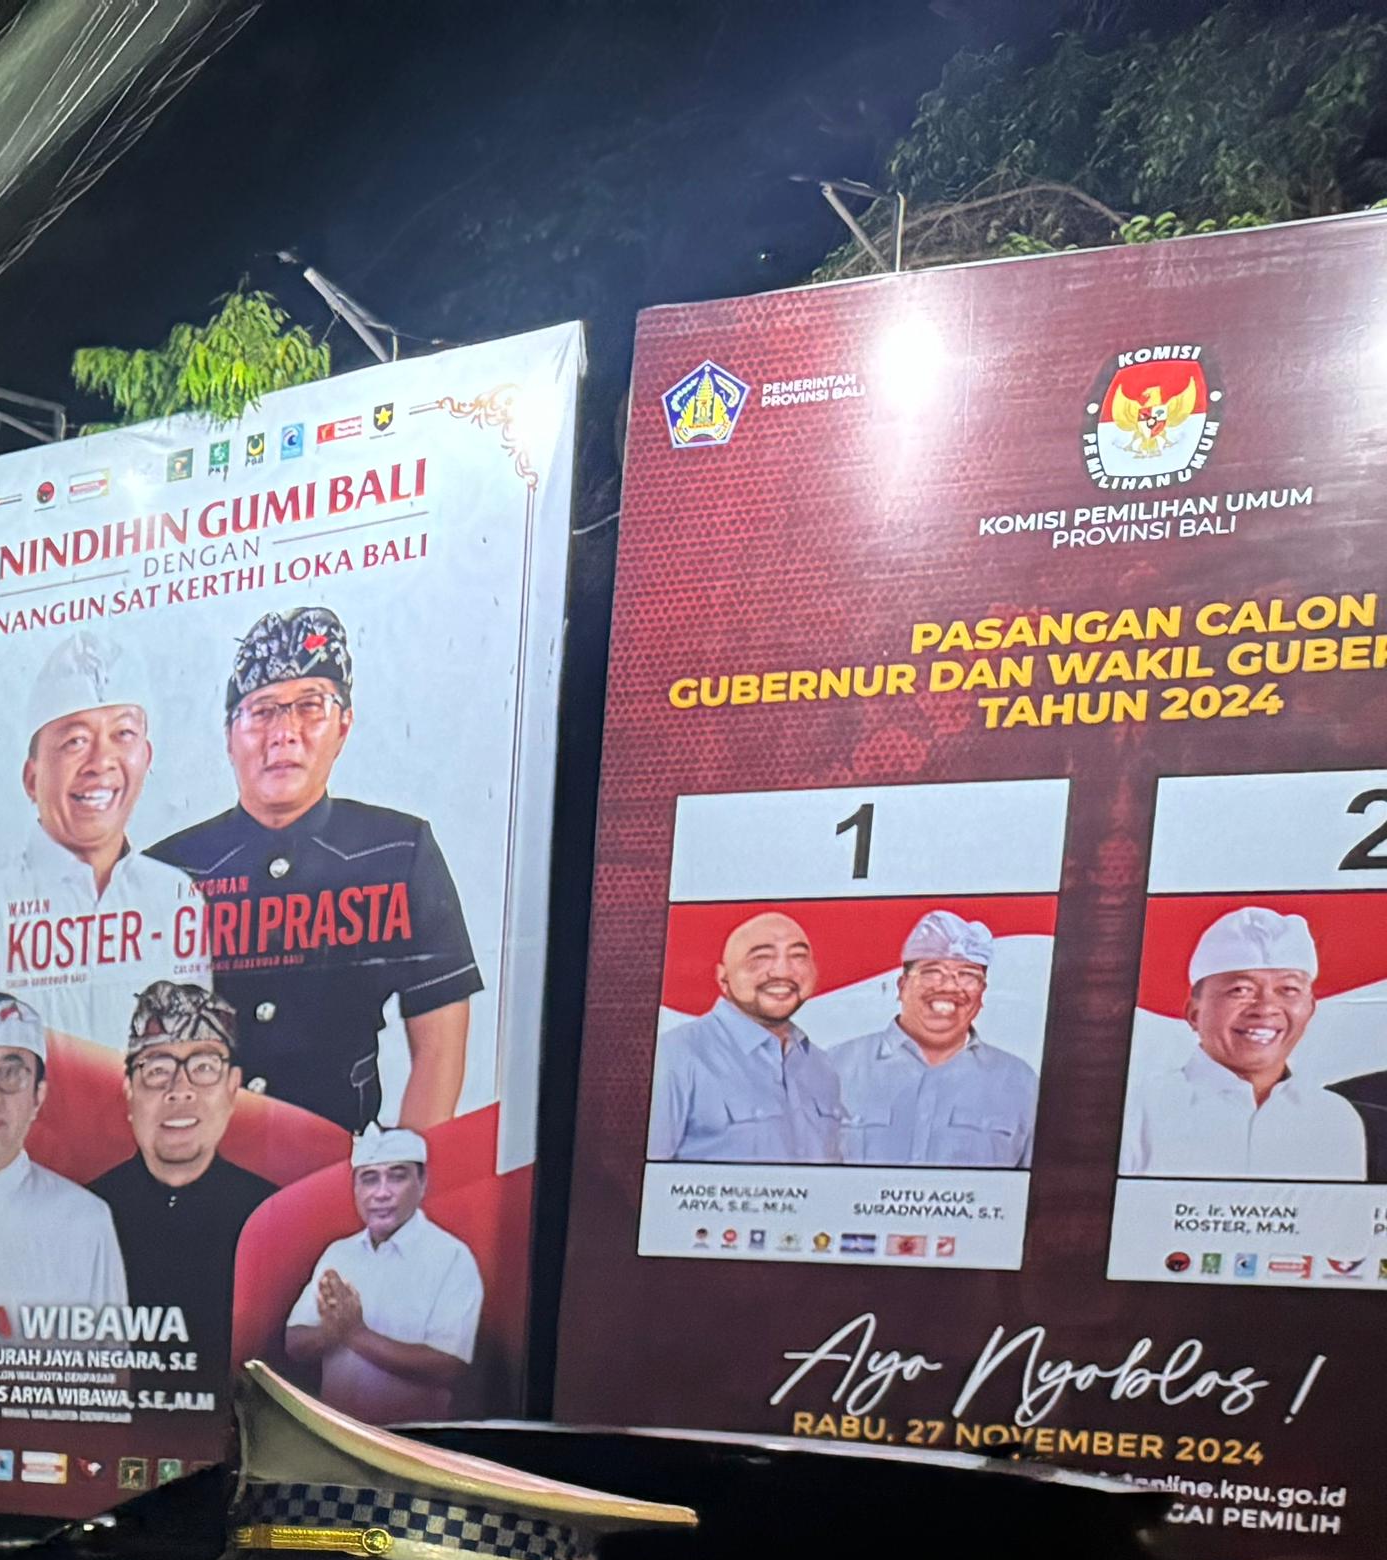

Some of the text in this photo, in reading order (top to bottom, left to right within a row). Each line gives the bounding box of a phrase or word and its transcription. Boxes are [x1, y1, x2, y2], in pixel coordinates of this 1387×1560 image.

[1117, 345, 1201, 368] KOMISI
[761, 384, 867, 408] PROVINSI BALI
[762, 373, 857, 395] PEMERINTAH
[1082, 420, 1220, 490] PEMILIHAN UMUM
[198, 481, 317, 539] GUMI
[327, 457, 428, 514] BALI
[978, 486, 1313, 536] KOMISI PEMILIHAN UMUM
[1051, 514, 1236, 549] PROVINSI BALI
[109, 584, 162, 615] SAT
[166, 564, 266, 605] KERTHI
[273, 548, 354, 585] LOKA
[363, 533, 428, 570] BALI
[144, 536, 262, 578] DENGAN
[910, 593, 1378, 656] PASANGAN CALON
[668, 662, 915, 711] GUBERNUR
[929, 653, 1035, 696] DAN
[1046, 643, 1214, 686] WAKIL
[977, 682, 1285, 730] TAHUN 2024
[834, 802, 875, 880] 1
[1337, 788, 1387, 872] 2
[188, 875, 250, 897] NYOMAN
[8, 898, 51, 917] WAYAN
[7, 910, 143, 974] KOSTER
[670, 1184, 716, 1198] MADE
[880, 1189, 975, 1204] PUTU AGUS
[1173, 1219, 1300, 1235] KOSTER, M.M.
[1174, 1203, 1200, 1216] Dr.
[1229, 1204, 1298, 1219] WAYAN
[20, 1305, 190, 1343] WIBAWA
[43, 1349, 84, 1367] JAYA
[87, 1350, 166, 1372] NEGARA,
[770, 1312, 1327, 1427] Ayo Nyoblos !
[10, 1386, 56, 1405] ARYA
[57, 1388, 134, 1409] WIBAWA,
[905, 1419, 945, 1445] 27
[955, 1421, 1164, 1461] NOVEMBER
[1174, 1435, 1266, 1466] 2024
[1165, 1502, 1342, 1535] GAI PEMILIH
